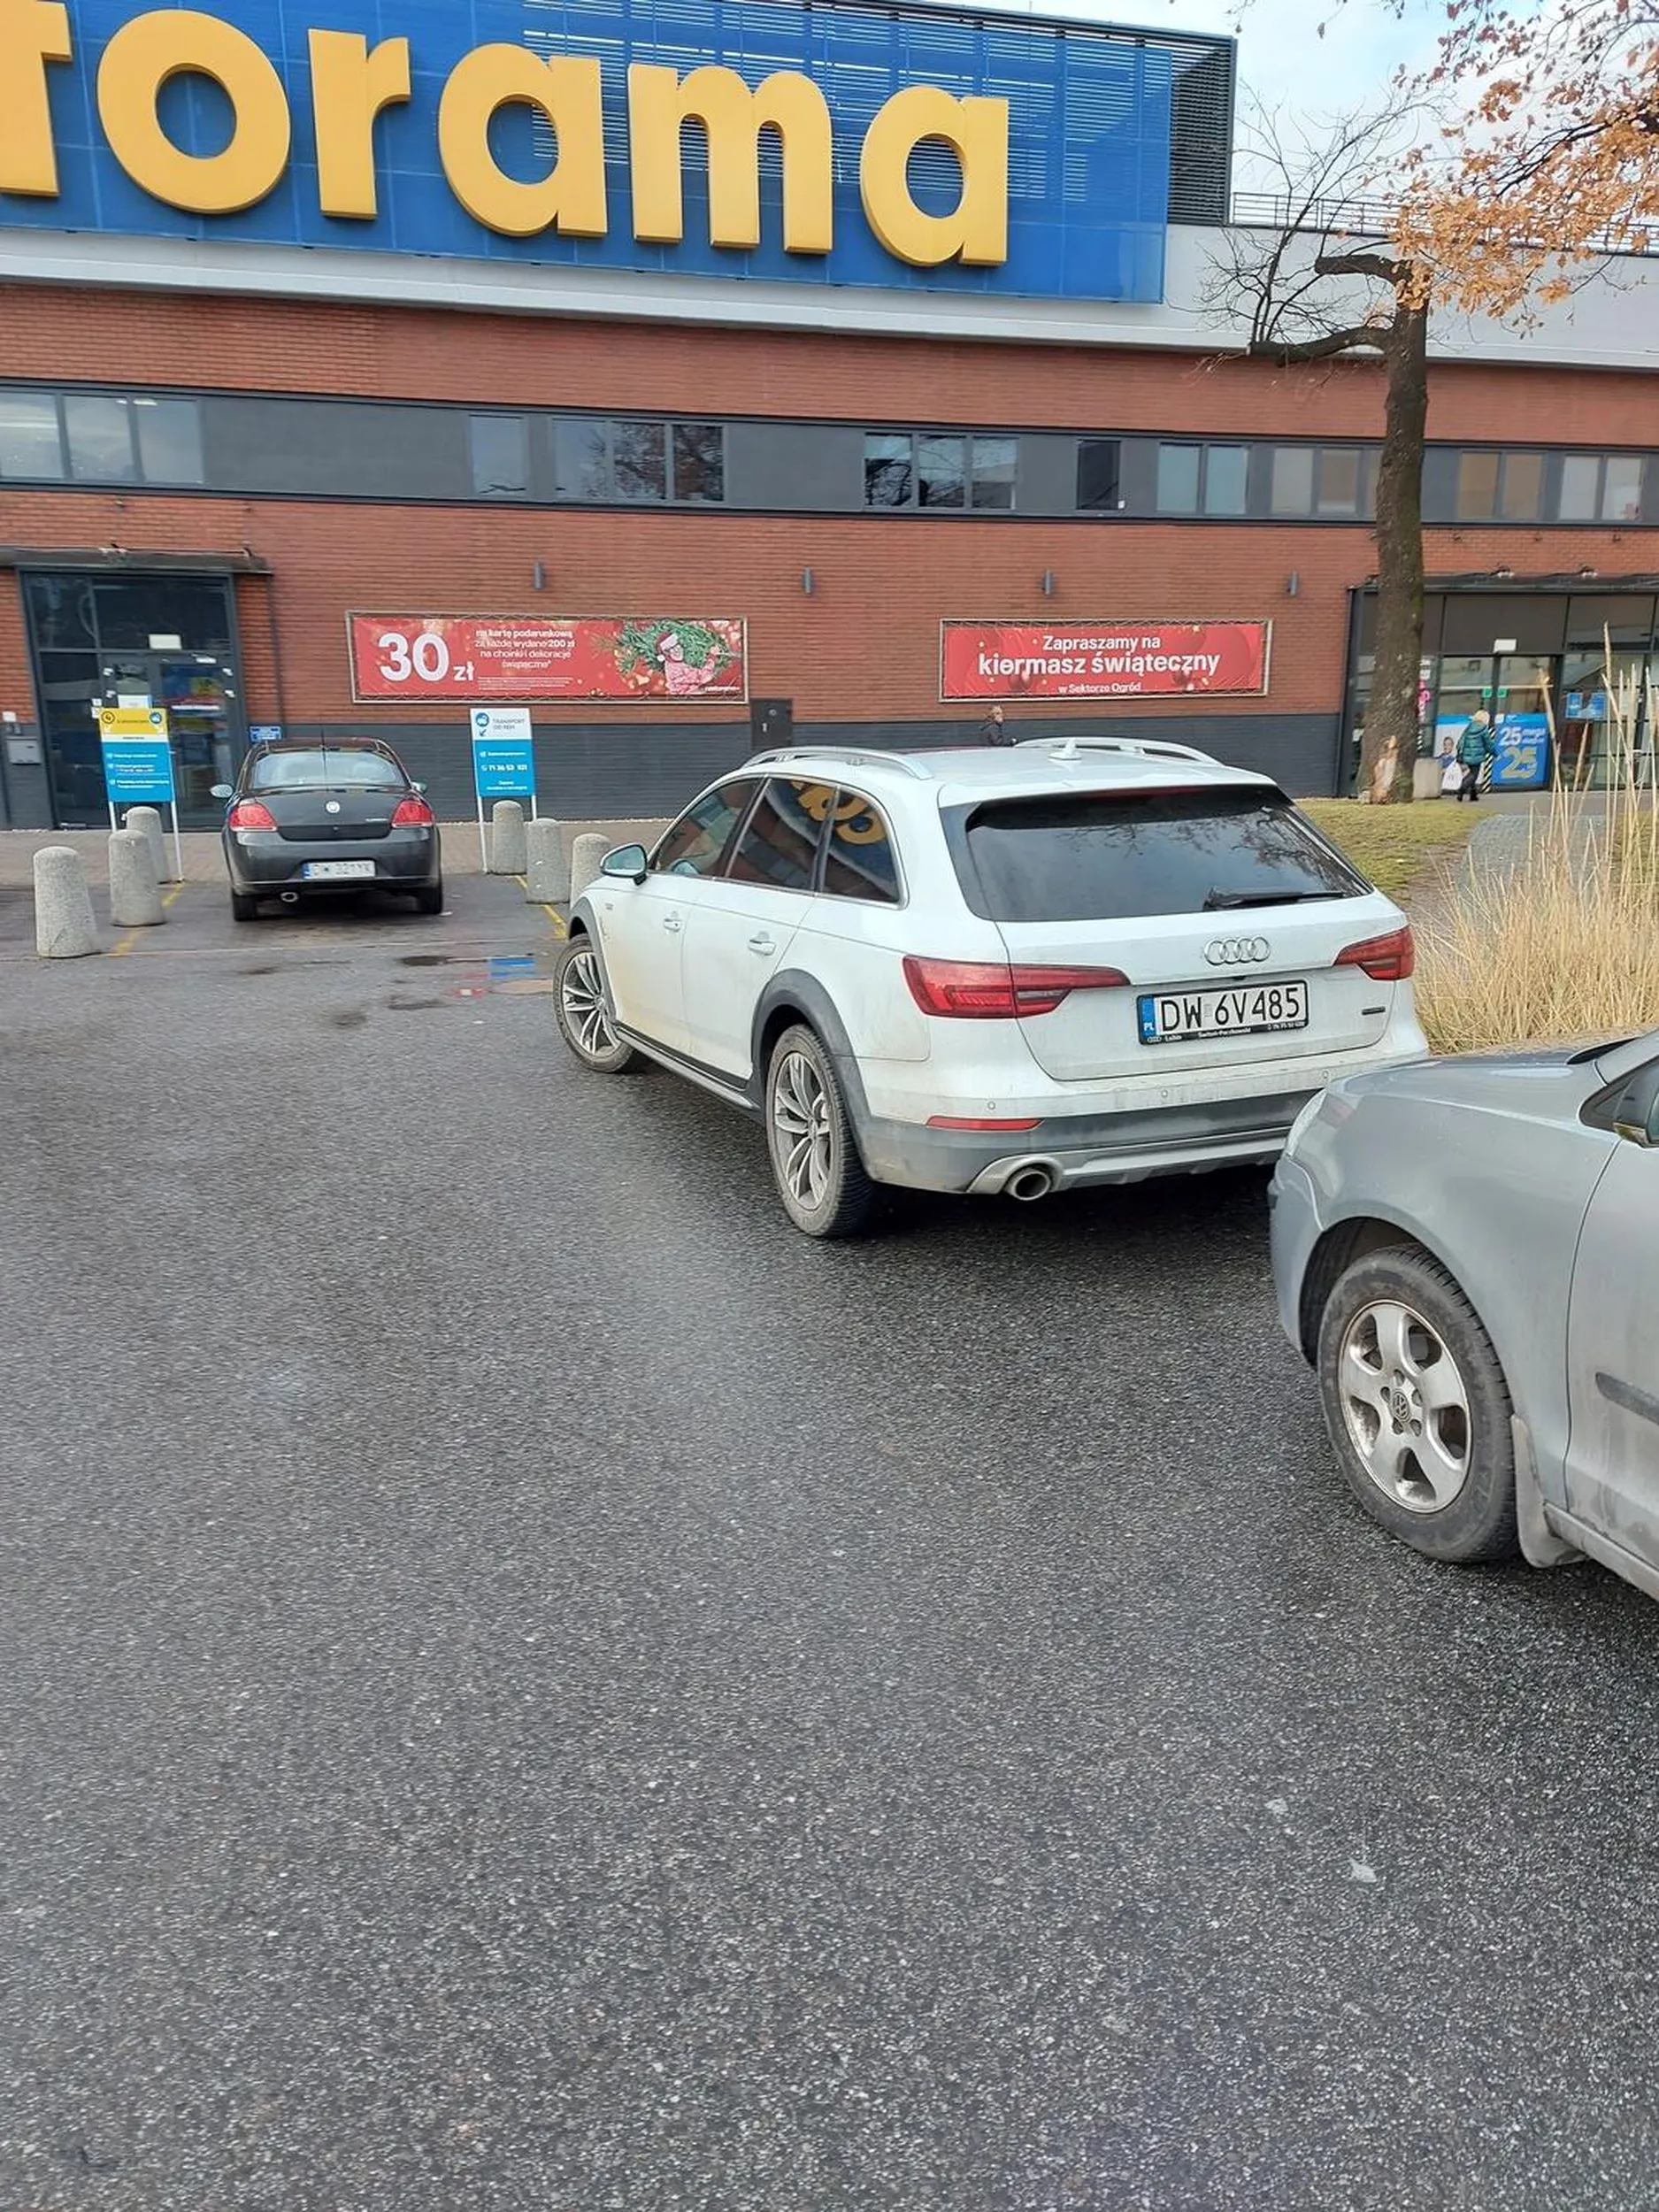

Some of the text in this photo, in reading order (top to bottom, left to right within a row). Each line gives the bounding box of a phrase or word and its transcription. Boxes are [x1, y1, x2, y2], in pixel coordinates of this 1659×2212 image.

[378, 632, 474, 681] 30 zł
[1042, 634, 1162, 654] Zapraszamy na
[978, 650, 1221, 677] kiermasz świąteczny
[1498, 726, 1522, 746] 25
[1501, 746, 1538, 780] 25
[1161, 987, 1300, 1032] DW 6V485
